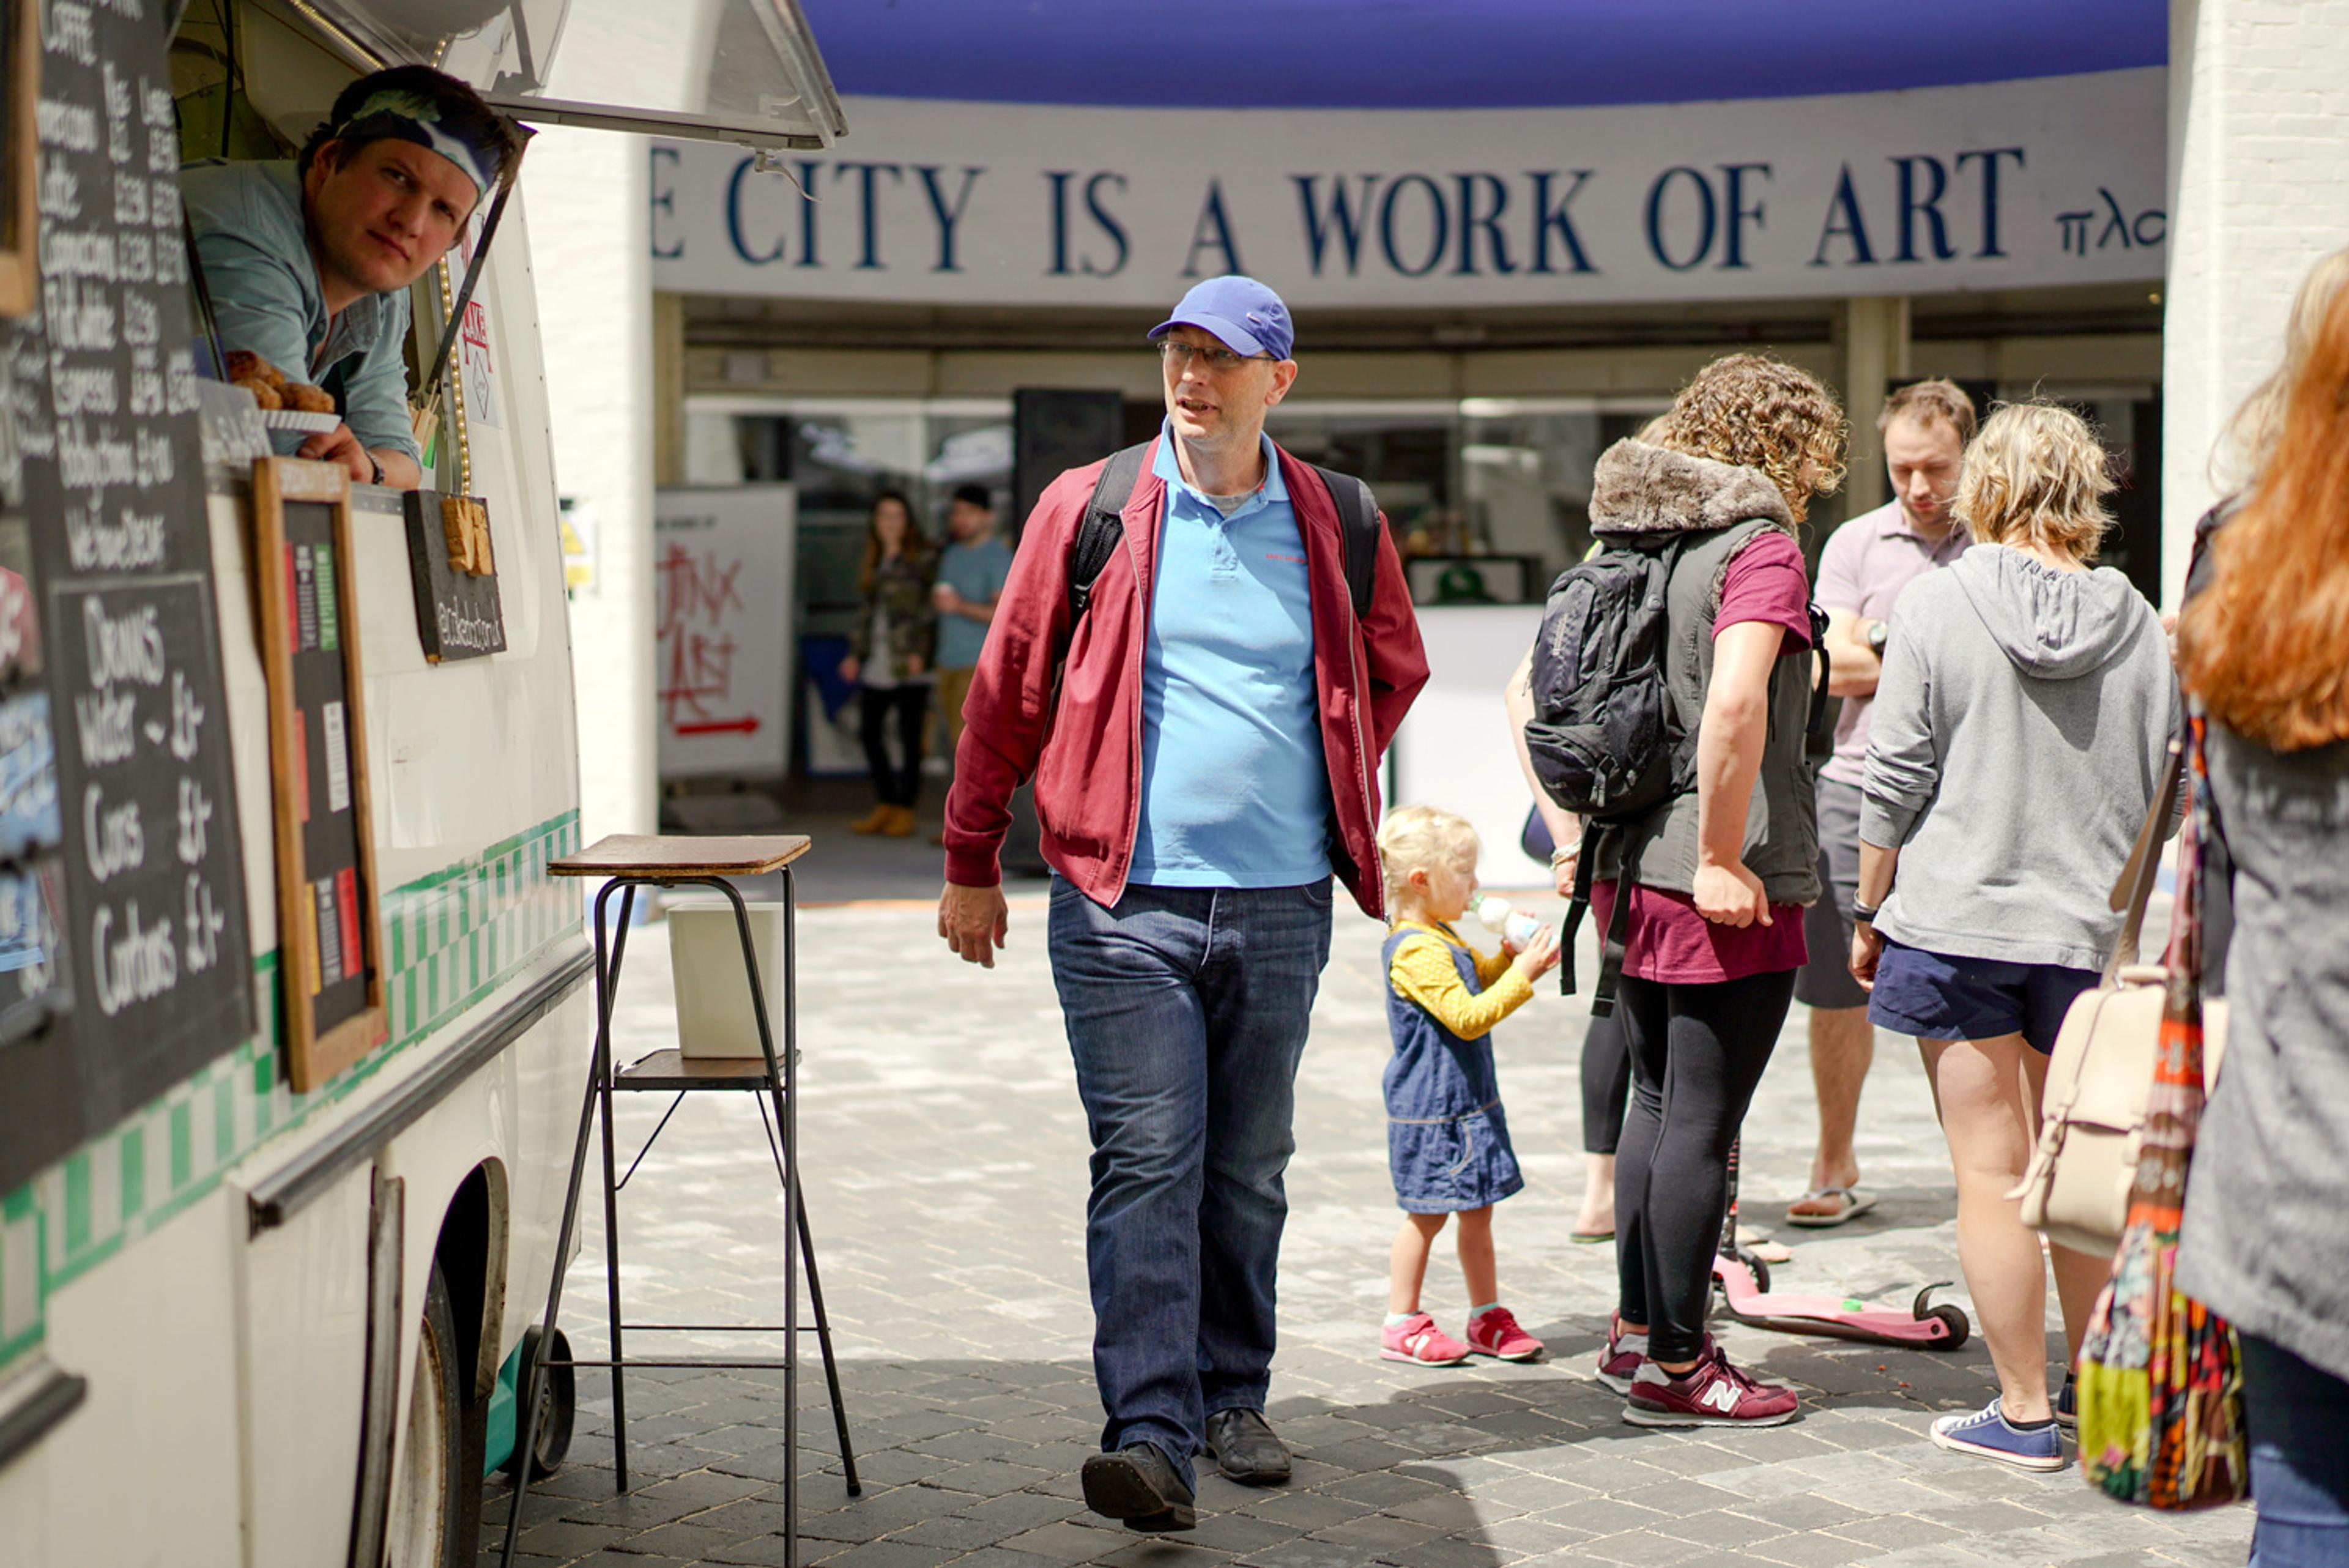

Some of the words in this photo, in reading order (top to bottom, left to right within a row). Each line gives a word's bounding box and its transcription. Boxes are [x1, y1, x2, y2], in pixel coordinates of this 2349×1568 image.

[724, 154, 986, 273] CITY
[1042, 170, 1132, 279] IS
[1178, 175, 1249, 279] A
[1286, 170, 1601, 279] WORK
[1644, 163, 1774, 273] OF
[1806, 147, 2025, 267] ART
[1701, 1380, 1742, 1413] N
